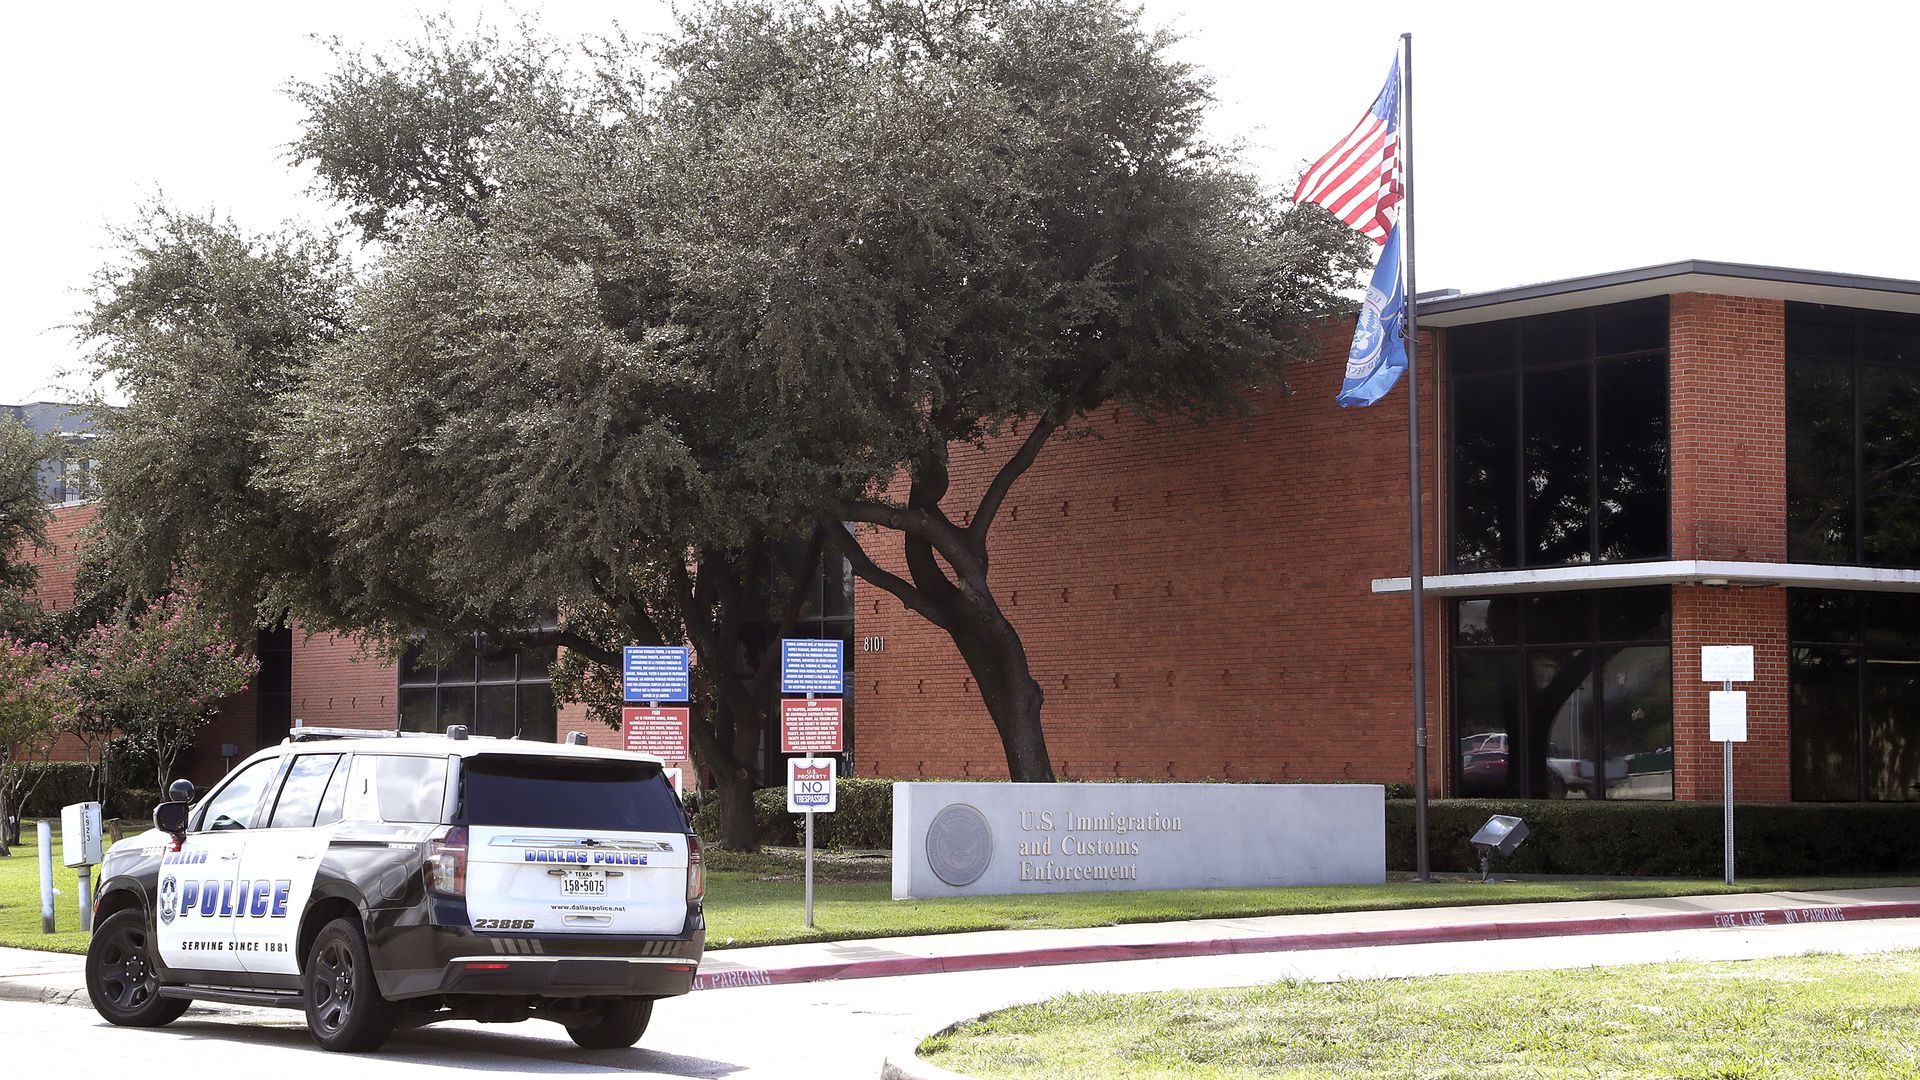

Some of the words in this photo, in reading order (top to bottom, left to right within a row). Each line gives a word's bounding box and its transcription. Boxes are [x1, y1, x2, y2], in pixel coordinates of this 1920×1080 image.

[863, 636, 884, 651] 8101
[801, 781, 823, 793] NO
[1018, 810, 1057, 831] U.S.
[1066, 811, 1183, 835] Immigration
[1018, 836, 1052, 856] and
[1061, 835, 1140, 856] Customs
[524, 849, 588, 863] DALLAS
[593, 851, 648, 866] POLICE
[1018, 860, 1138, 881] Enforcement
[179, 879, 292, 919] POLICE
[550, 903, 626, 912] www.dallaspolice.net
[1802, 907, 1846, 922] PARKING
[473, 918, 536, 930] 23886
[181, 941, 224, 951] SERVING
[228, 941, 259, 951] SINCE
[264, 942, 288, 952] 1881
[711, 968, 772, 989] PARKING
